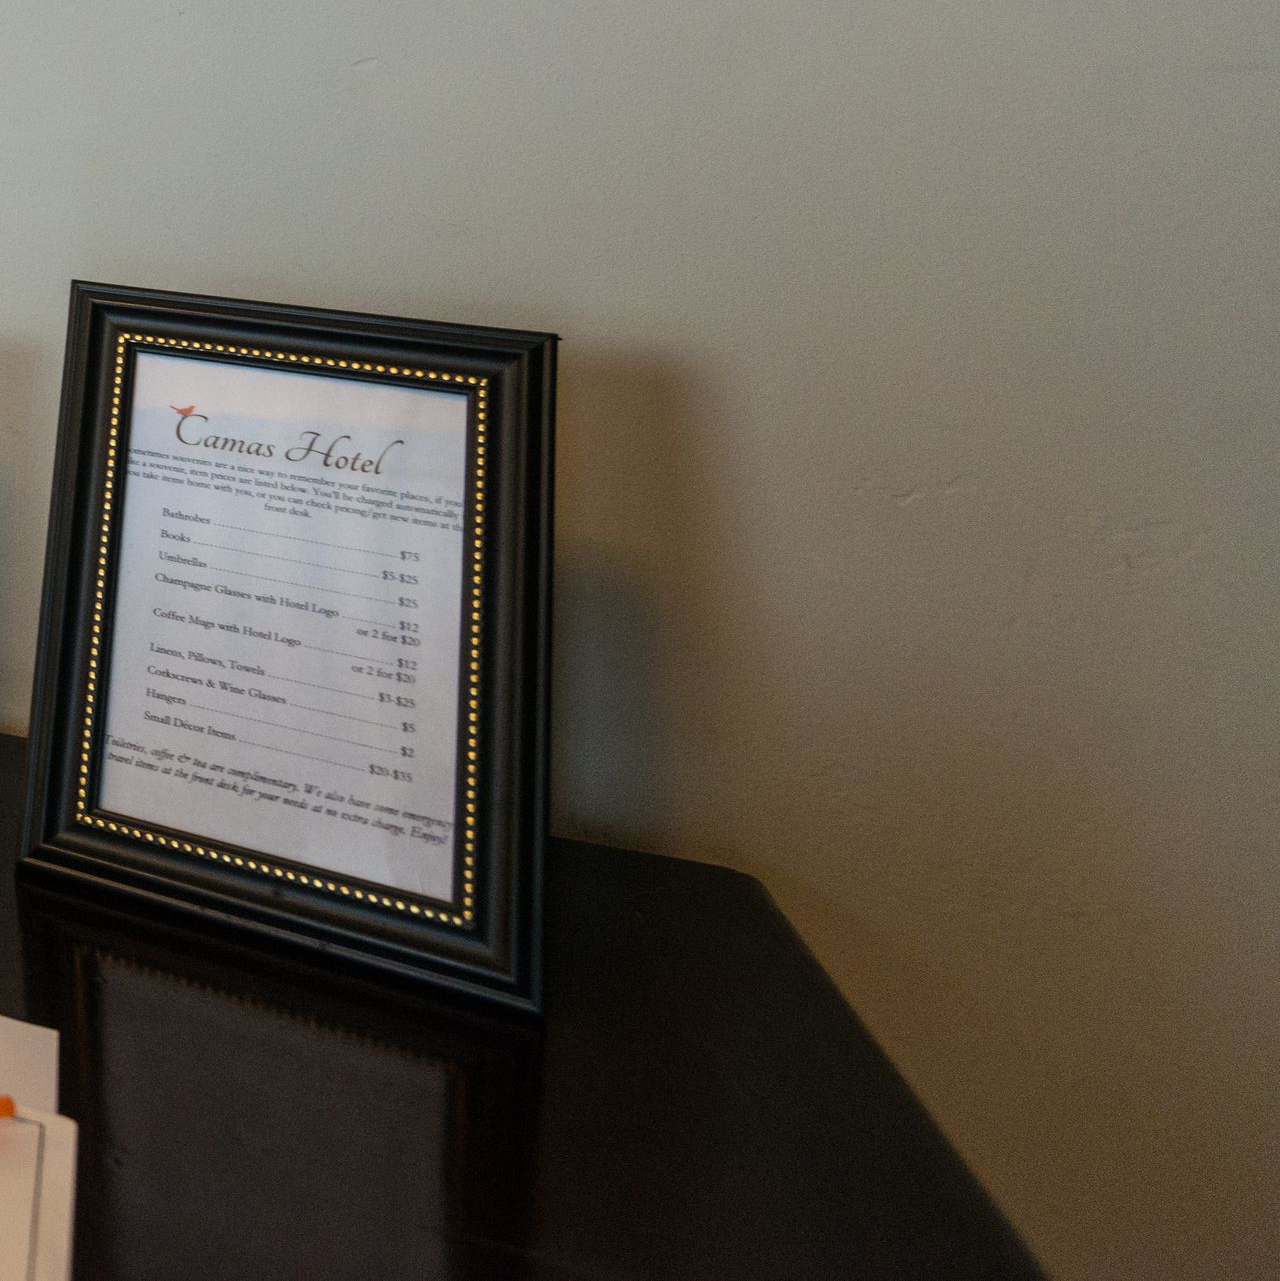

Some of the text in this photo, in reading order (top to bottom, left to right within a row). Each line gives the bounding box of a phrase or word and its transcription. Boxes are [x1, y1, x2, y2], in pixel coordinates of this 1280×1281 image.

[175, 413, 405, 475] Camas Hotel
[161, 507, 211, 525] Bathrobes
[160, 529, 191, 544] Books
[158, 551, 208, 569] Umbrellas
[154, 572, 212, 593] Champagne
[214, 584, 253, 600] Glasses
[254, 593, 277, 605] with
[279, 597, 309, 612] Hotel
[312, 603, 340, 619] Logo
[152, 607, 186, 623] Coffee
[188, 615, 216, 630] Mugs
[218, 622, 240, 634] with
[242, 625, 272, 640] Hotel
[274, 632, 302, 647] Logo
[356, 628, 369, 637] or
[371, 629, 379, 639] 2
[381, 631, 398, 643] for
[149, 642, 185, 659] Linens,
[187, 650, 226, 669] Pillows,
[228, 659, 266, 676] Towels
[147, 664, 204, 686] Corkscrews
[206, 679, 216, 689] &
[218, 680, 246, 695] Wine
[248, 687, 287, 704] Glasses
[366, 666, 374, 676] 2
[376, 668, 393, 679] for
[146, 687, 187, 705] Hangers
[144, 710, 171, 726] Small
[207, 725, 237, 741] Items
